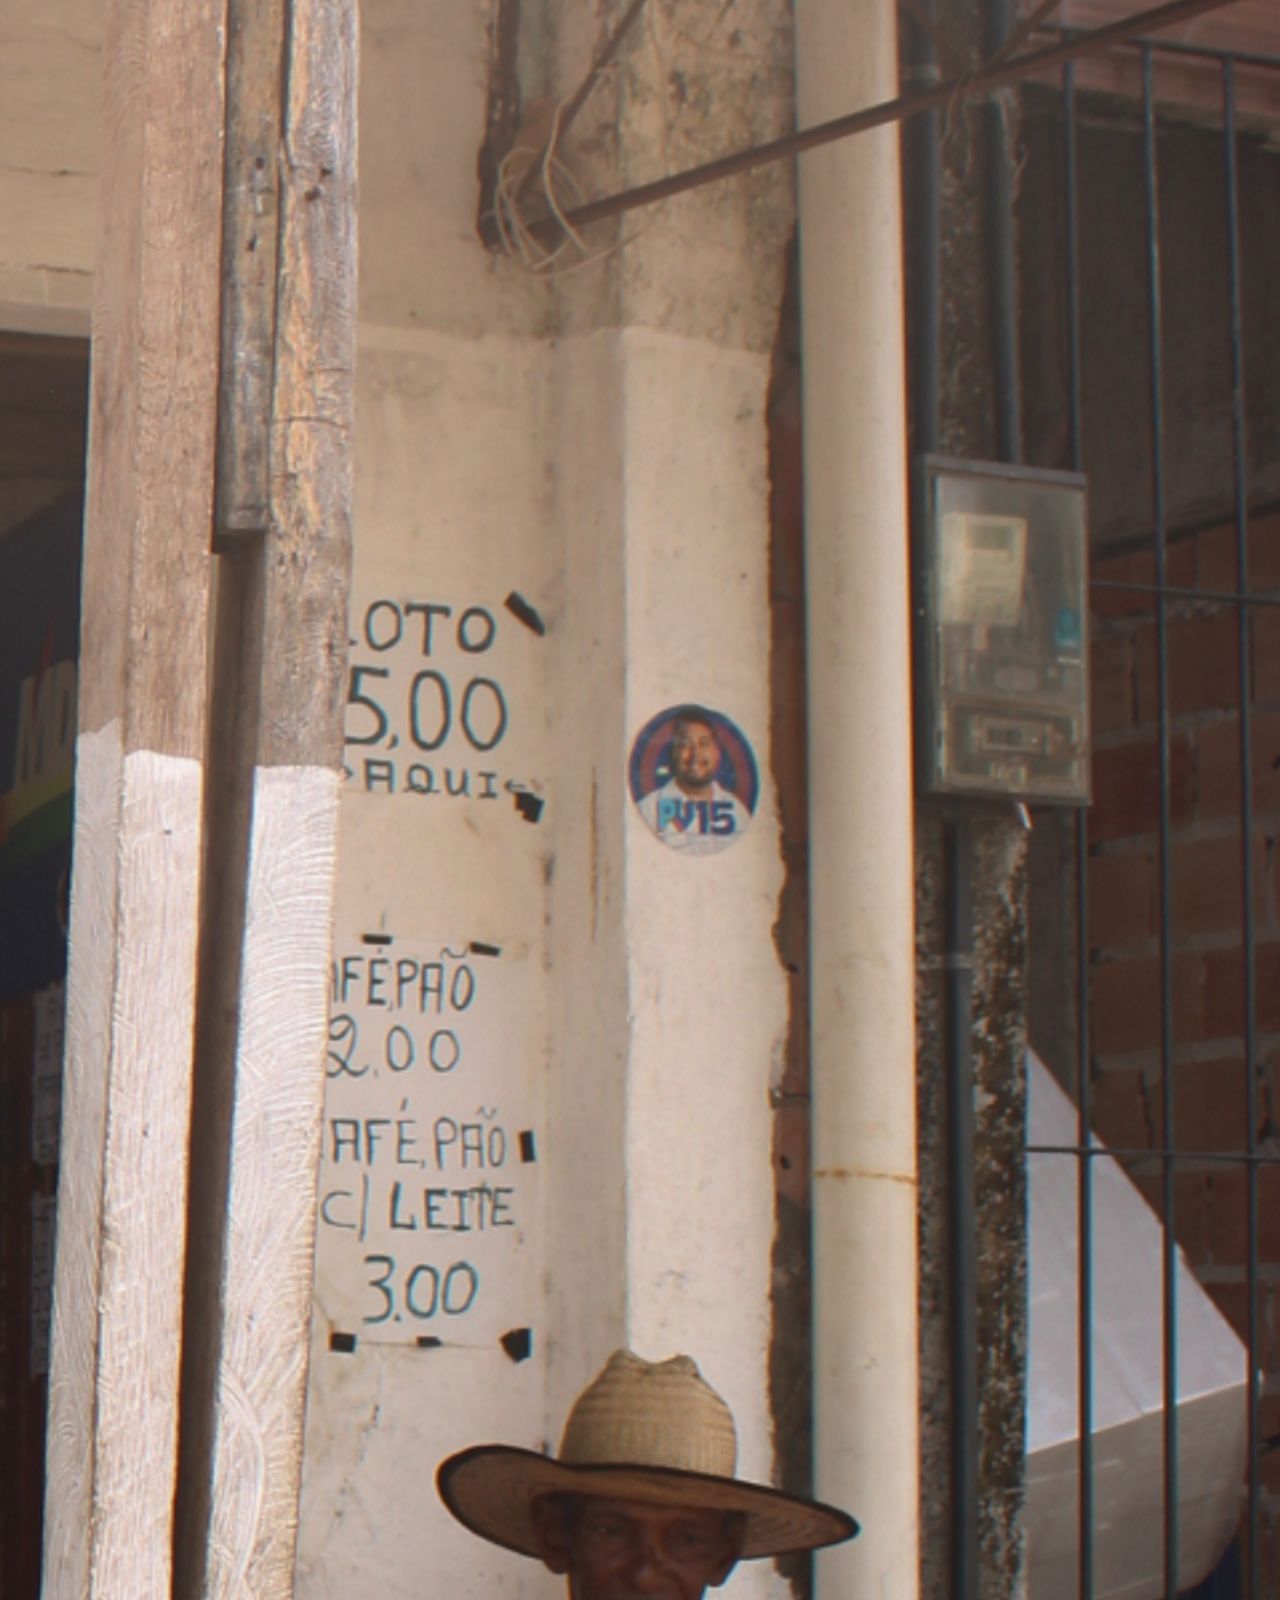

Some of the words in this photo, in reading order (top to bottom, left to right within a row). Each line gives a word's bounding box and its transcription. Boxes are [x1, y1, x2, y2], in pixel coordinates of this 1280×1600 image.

[349, 599, 496, 657] OTO
[343, 665, 508, 751] 5,00
[364, 757, 499, 799] AQUI
[390, 1179, 516, 1232] LEITE
